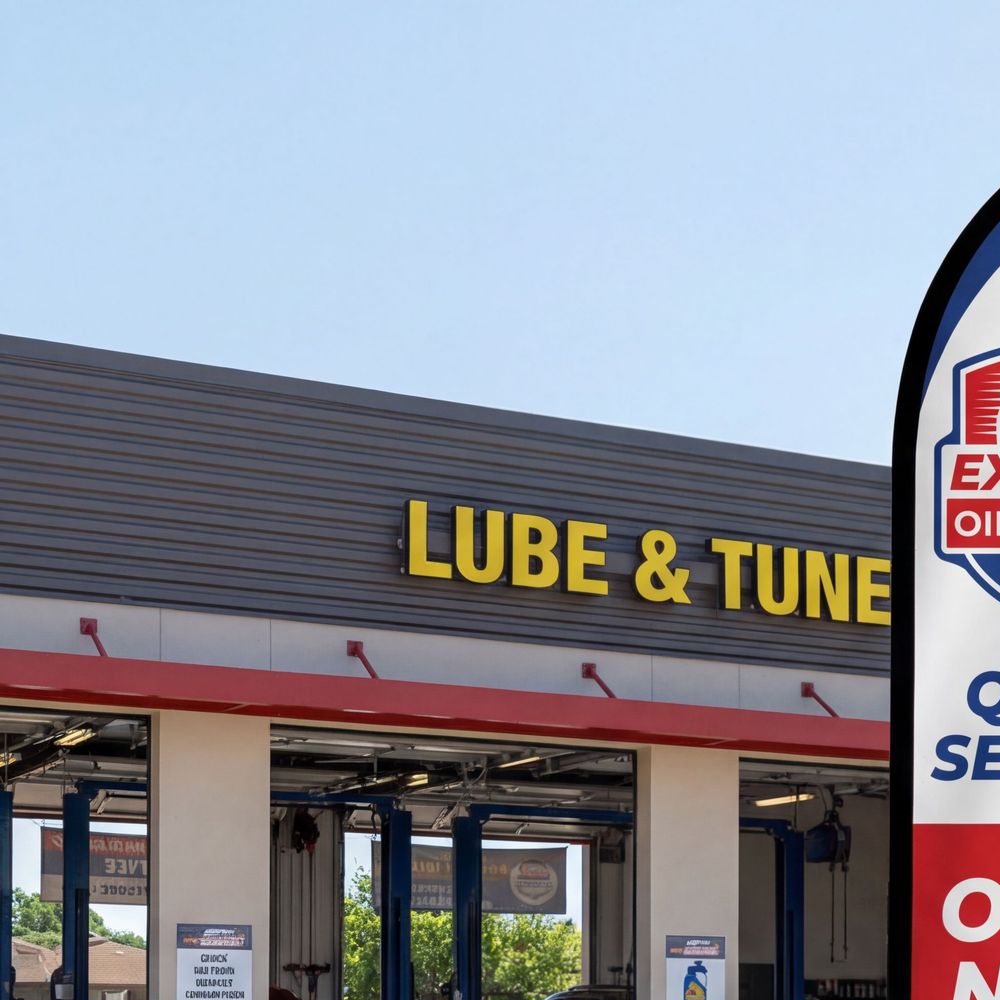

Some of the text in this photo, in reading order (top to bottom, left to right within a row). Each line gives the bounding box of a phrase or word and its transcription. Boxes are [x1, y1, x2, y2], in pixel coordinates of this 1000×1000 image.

[407, 501, 891, 624] LUBE & TUNE
